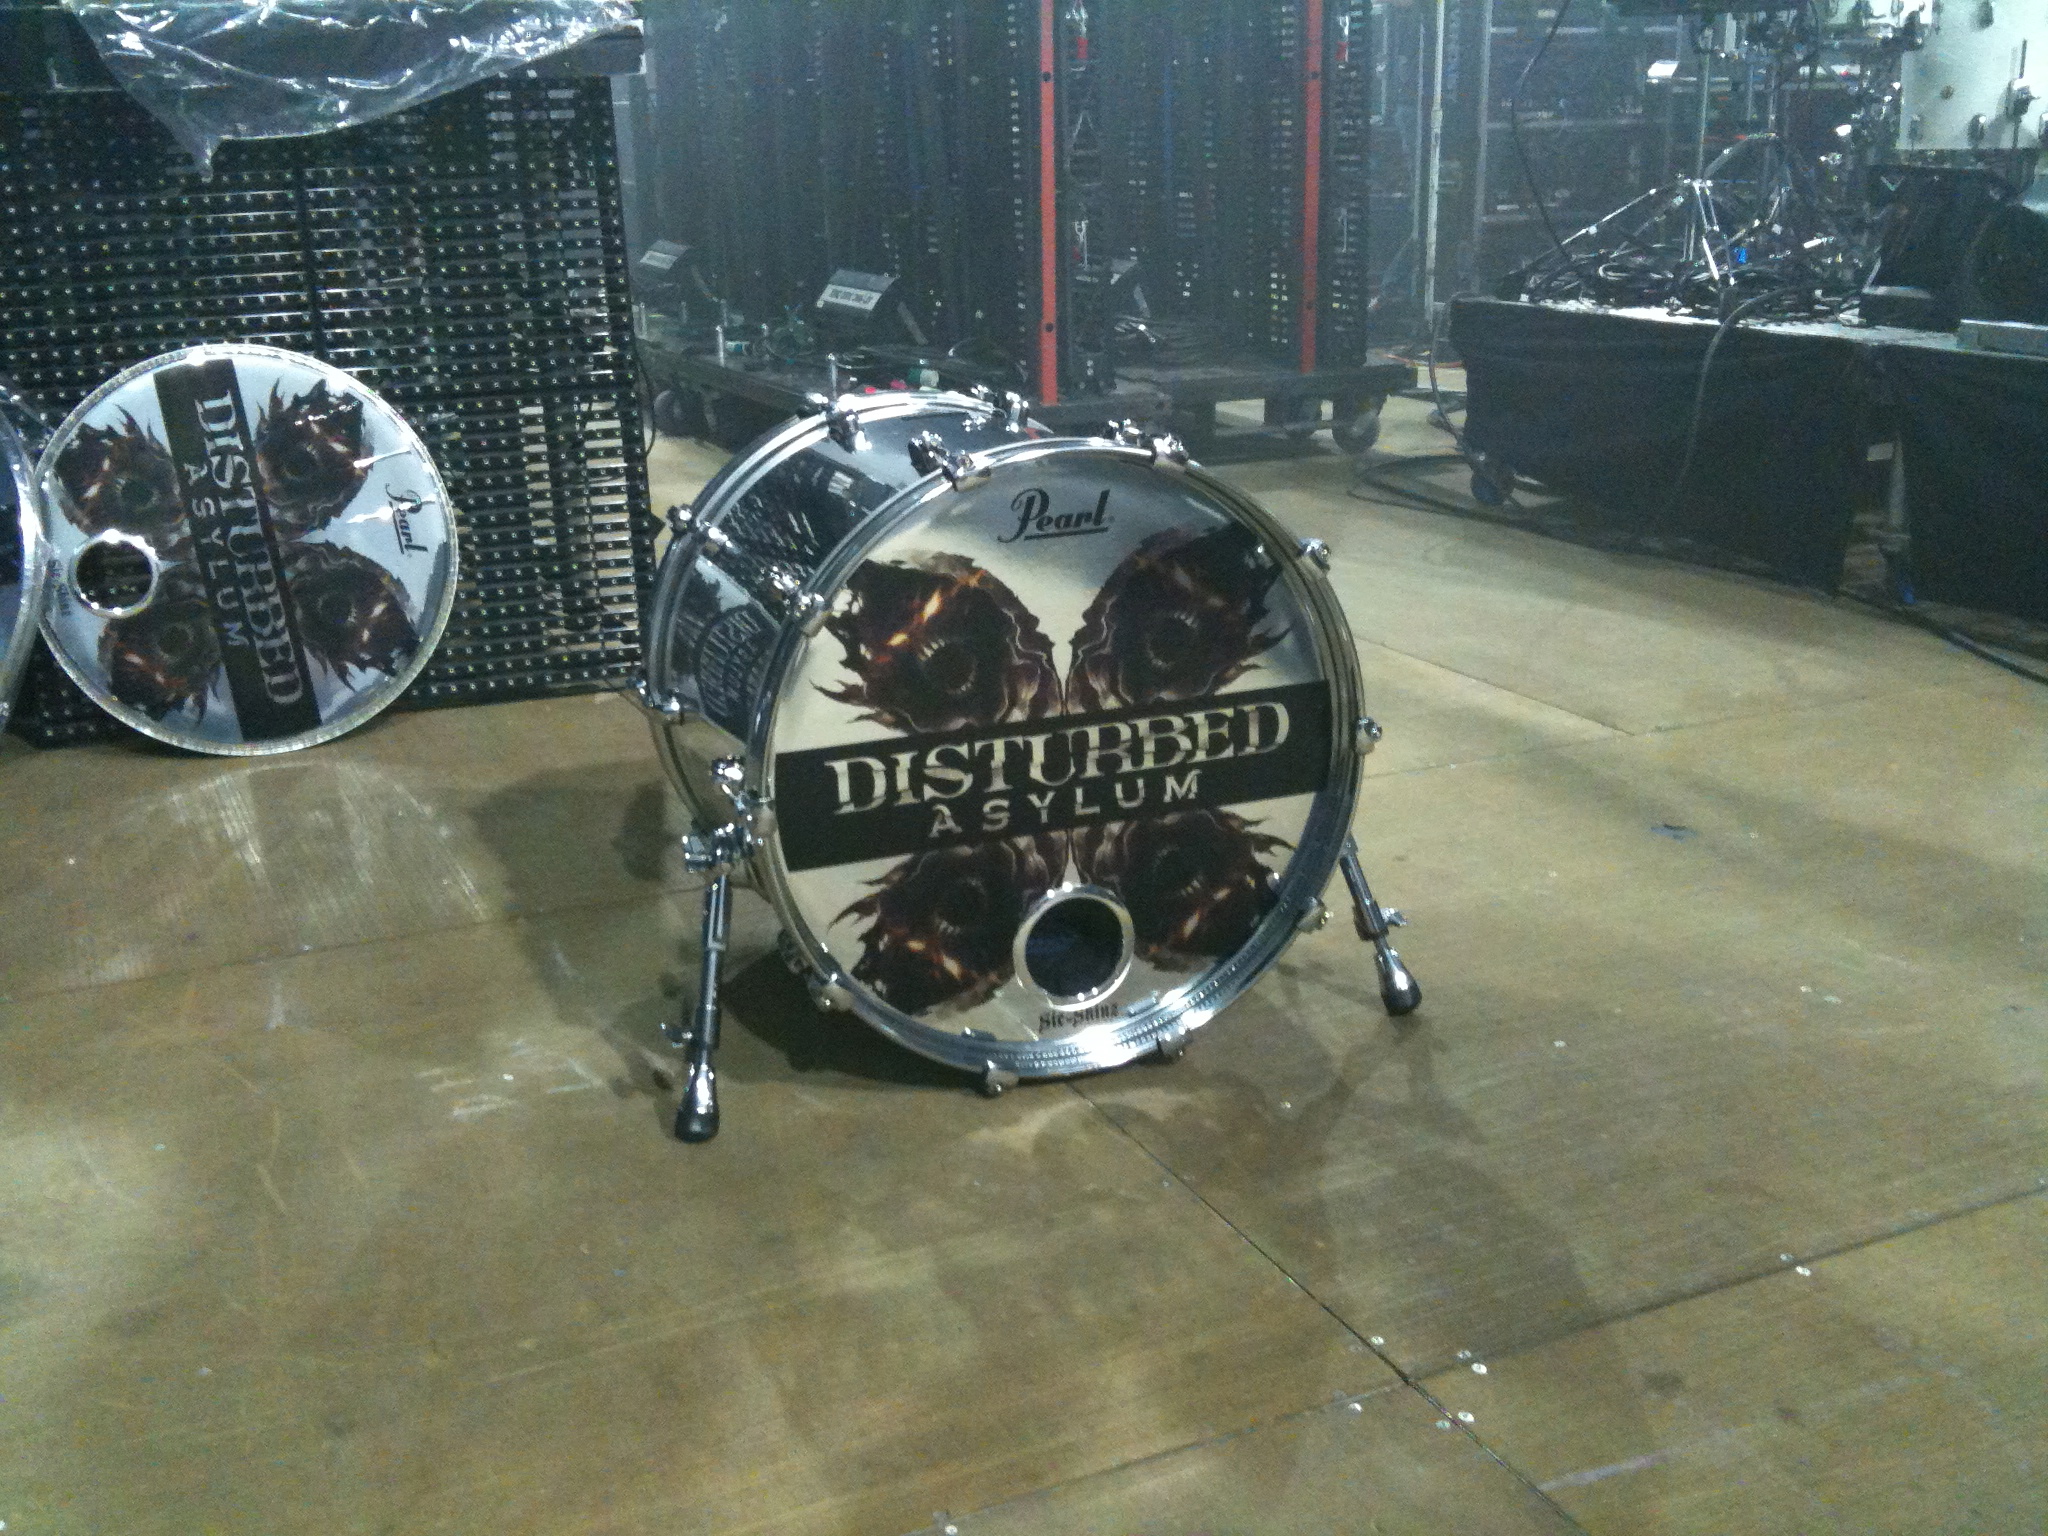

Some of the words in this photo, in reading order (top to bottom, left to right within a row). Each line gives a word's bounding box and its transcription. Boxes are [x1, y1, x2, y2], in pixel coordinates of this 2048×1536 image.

[184, 462, 250, 646] ASYLUM
[195, 389, 303, 704] DISTURBED
[997, 486, 1111, 543] Pearl
[824, 700, 1290, 816] DISTURBED
[928, 770, 1201, 839] ASYLUM
